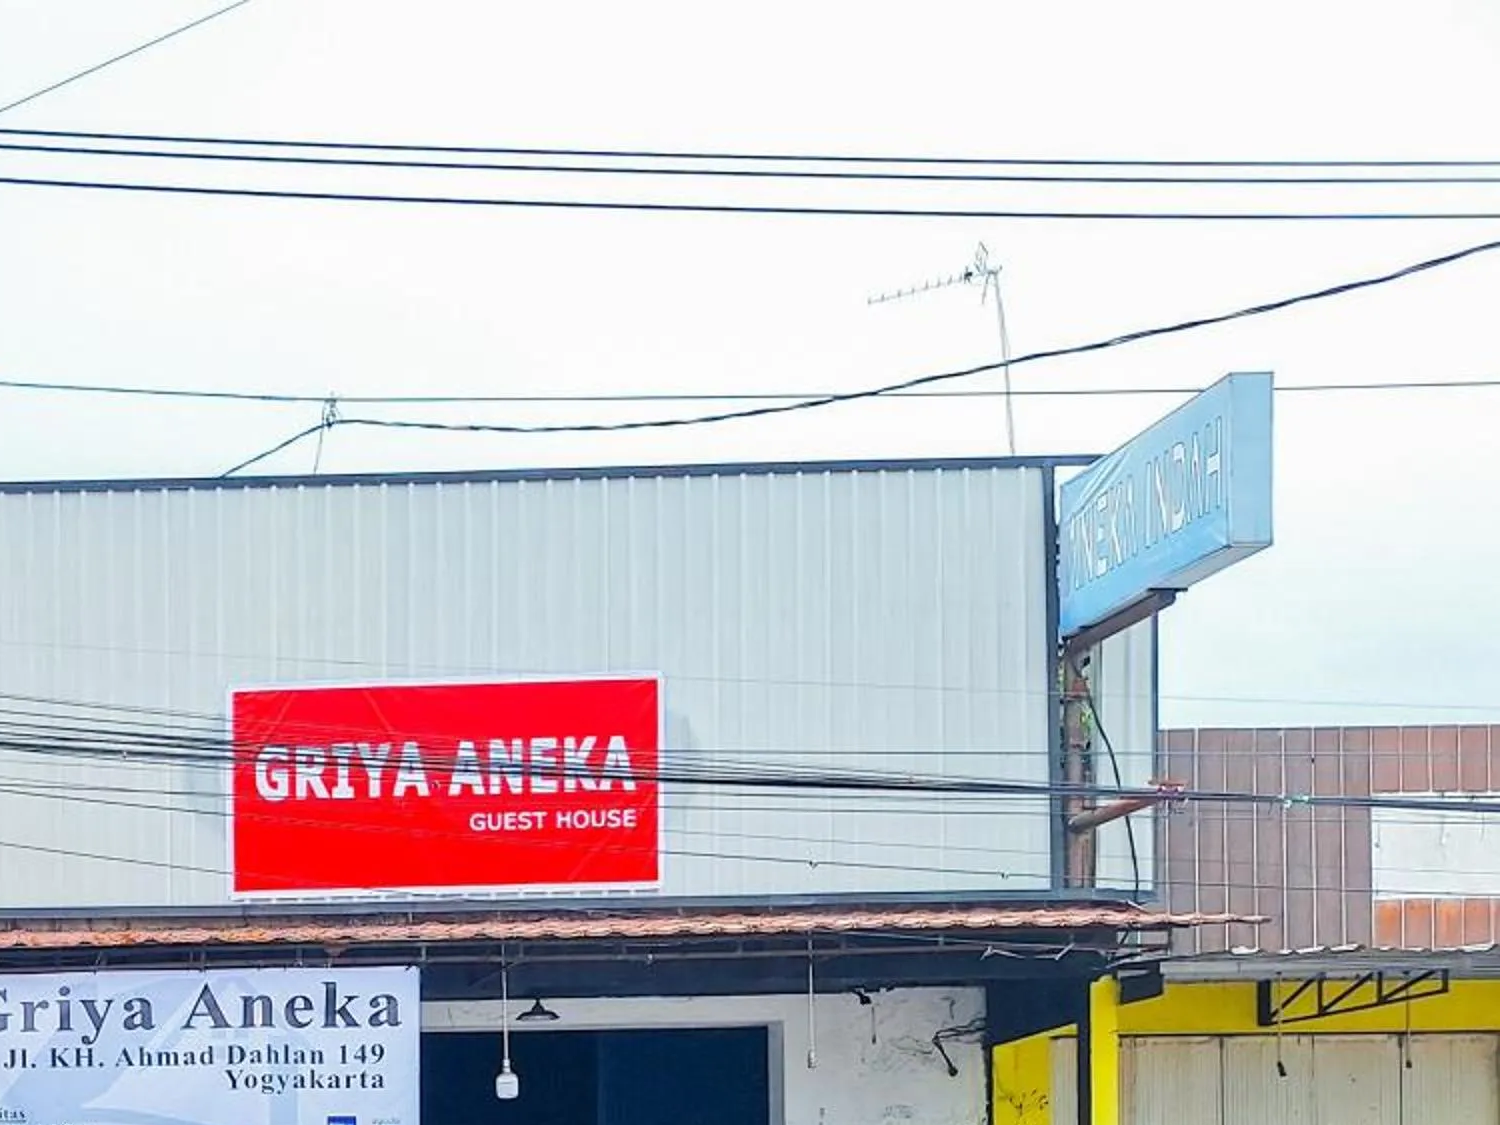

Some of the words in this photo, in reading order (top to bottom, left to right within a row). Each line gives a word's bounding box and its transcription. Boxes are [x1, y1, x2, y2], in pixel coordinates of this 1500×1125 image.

[1145, 415, 1222, 549] INDAH
[255, 740, 430, 801] GRIYA
[448, 735, 636, 797] ANEKA
[469, 811, 547, 832] GUEST
[556, 809, 637, 830] HOUSE
[184, 981, 403, 1032] Aneka
[3, 1049, 36, 1070] Jl.
[49, 1048, 104, 1068] KH.
[114, 1045, 214, 1067] Ahmad
[227, 1044, 325, 1066] Dahlan
[338, 1044, 386, 1065] 149
[223, 1069, 386, 1094] Yogyakarta
